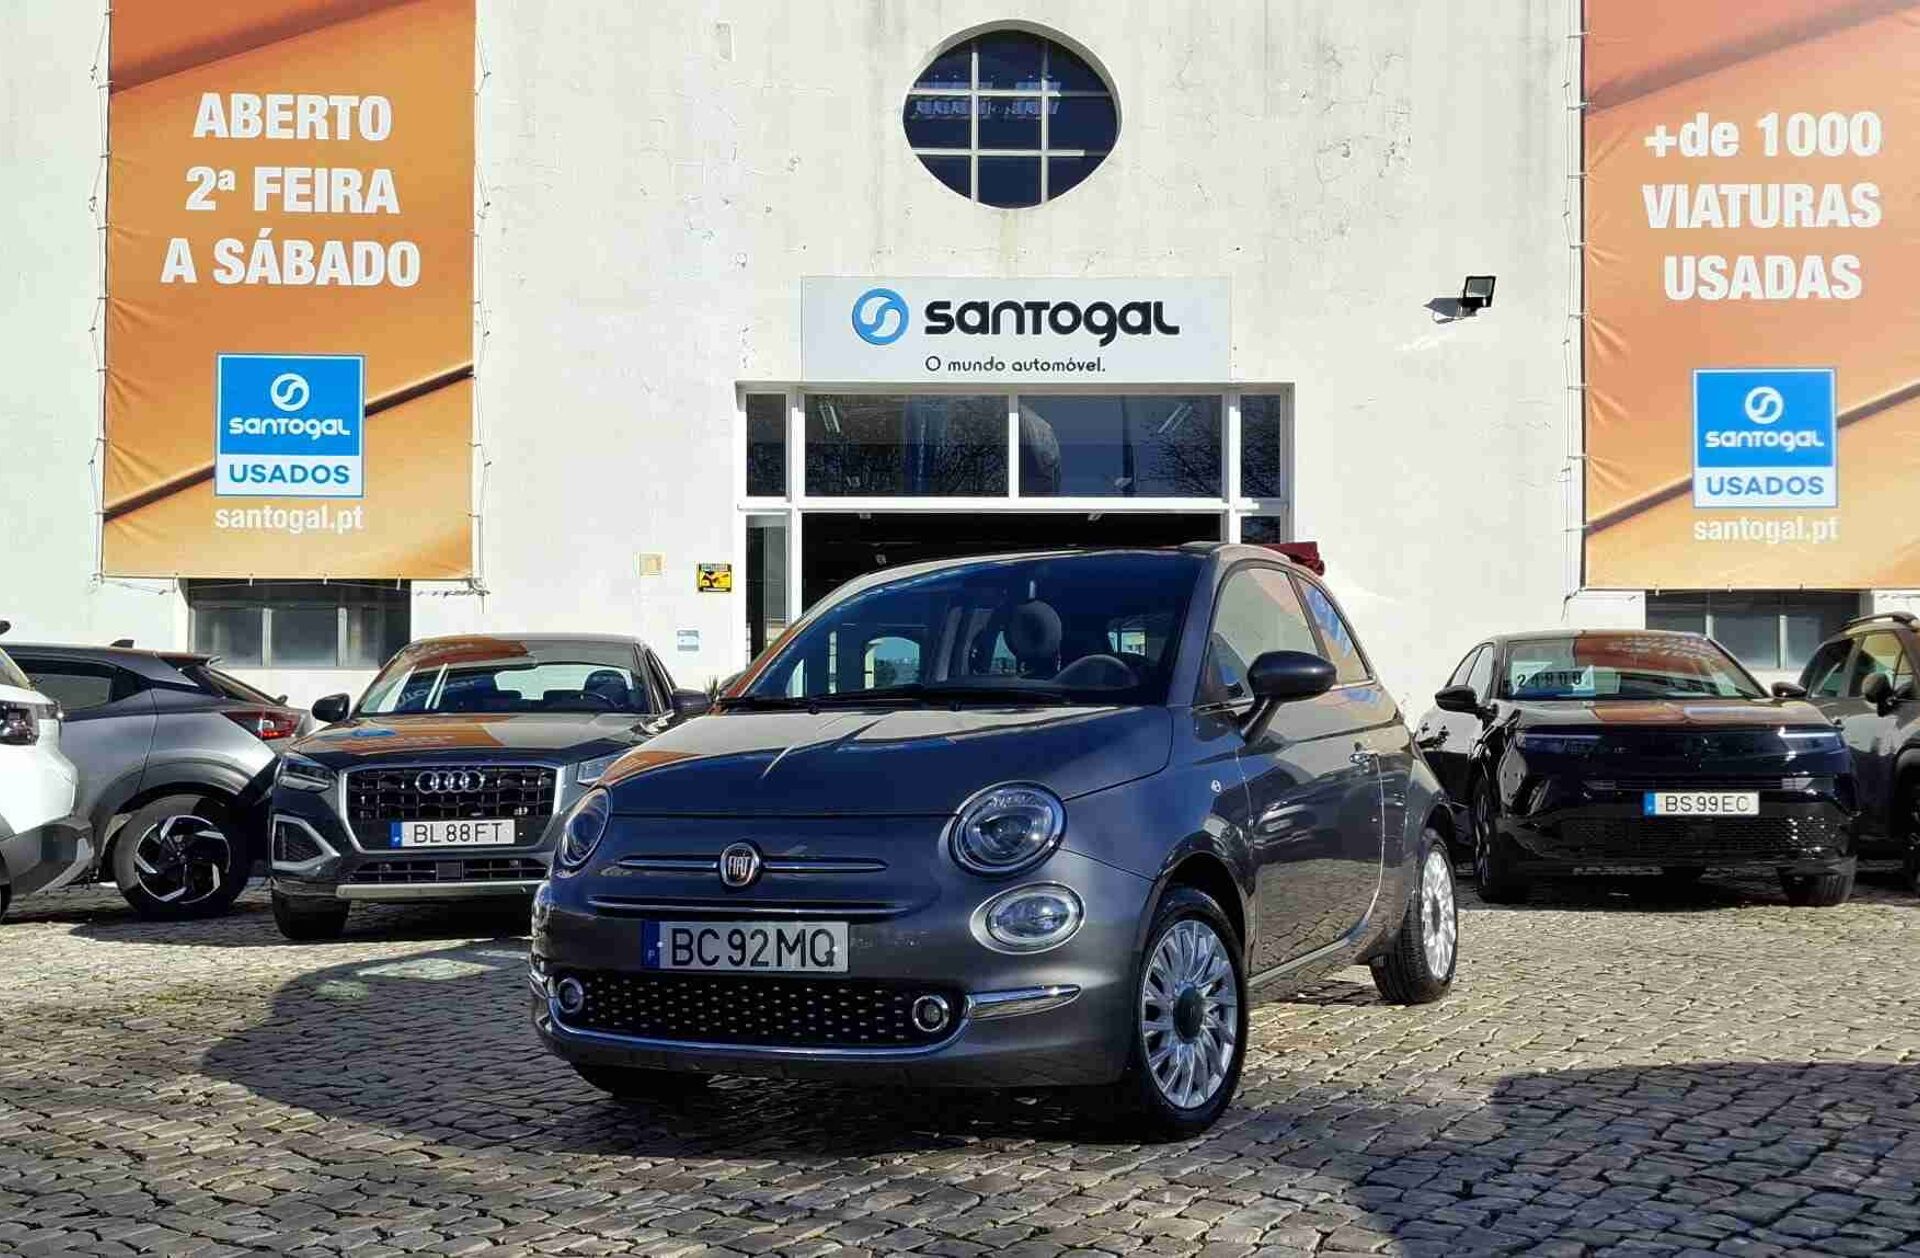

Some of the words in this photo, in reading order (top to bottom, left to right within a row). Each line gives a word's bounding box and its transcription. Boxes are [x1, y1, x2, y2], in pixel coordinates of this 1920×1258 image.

[193, 93, 392, 141] ABERTO
[1646, 113, 1740, 157] +de
[1757, 112, 1883, 157] 1000
[253, 167, 401, 214] FEIRA
[1642, 183, 1882, 229] VIATURAS
[160, 238, 197, 284] A
[212, 228, 421, 287] SÁBADO
[1664, 255, 1862, 301] USADAS
[925, 356, 941, 372] O
[948, 355, 1006, 372] mundo
[1012, 355, 1106, 373] automóvel.
[229, 463, 350, 485] USADOS
[1706, 476, 1825, 496] USADOS
[215, 505, 364, 534] santogal.pt
[1694, 516, 1840, 544] santogal.pt
[727, 855, 751, 876] FIAT
